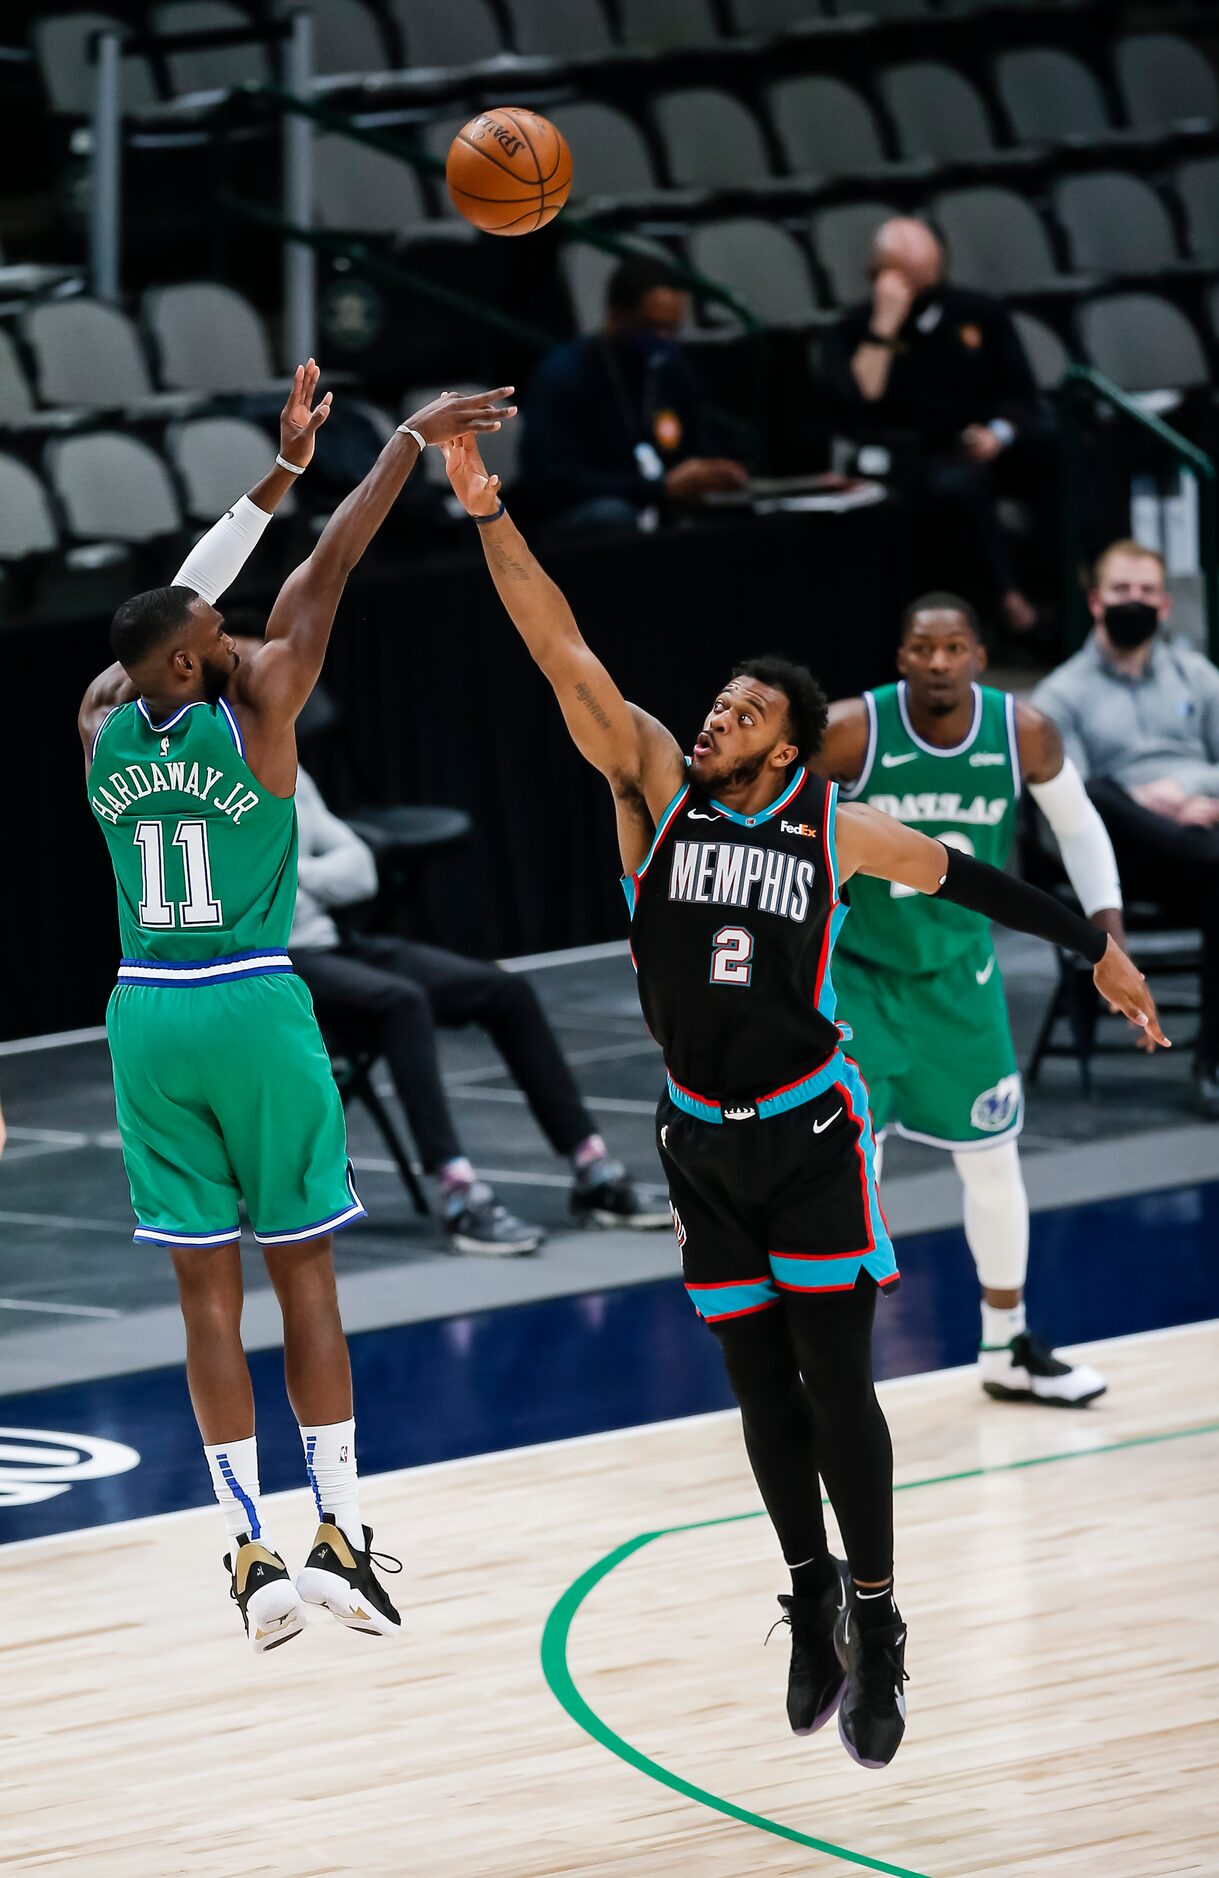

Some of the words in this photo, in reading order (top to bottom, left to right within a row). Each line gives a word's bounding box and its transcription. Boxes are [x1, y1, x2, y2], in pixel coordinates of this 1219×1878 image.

[92, 762, 223, 824] HARDAWAY
[867, 793, 1008, 825] DALLAS
[780, 820, 817, 838] FedEx
[133, 820, 223, 928] 11
[668, 840, 816, 923] MEMPHIS
[709, 925, 754, 987] 2
